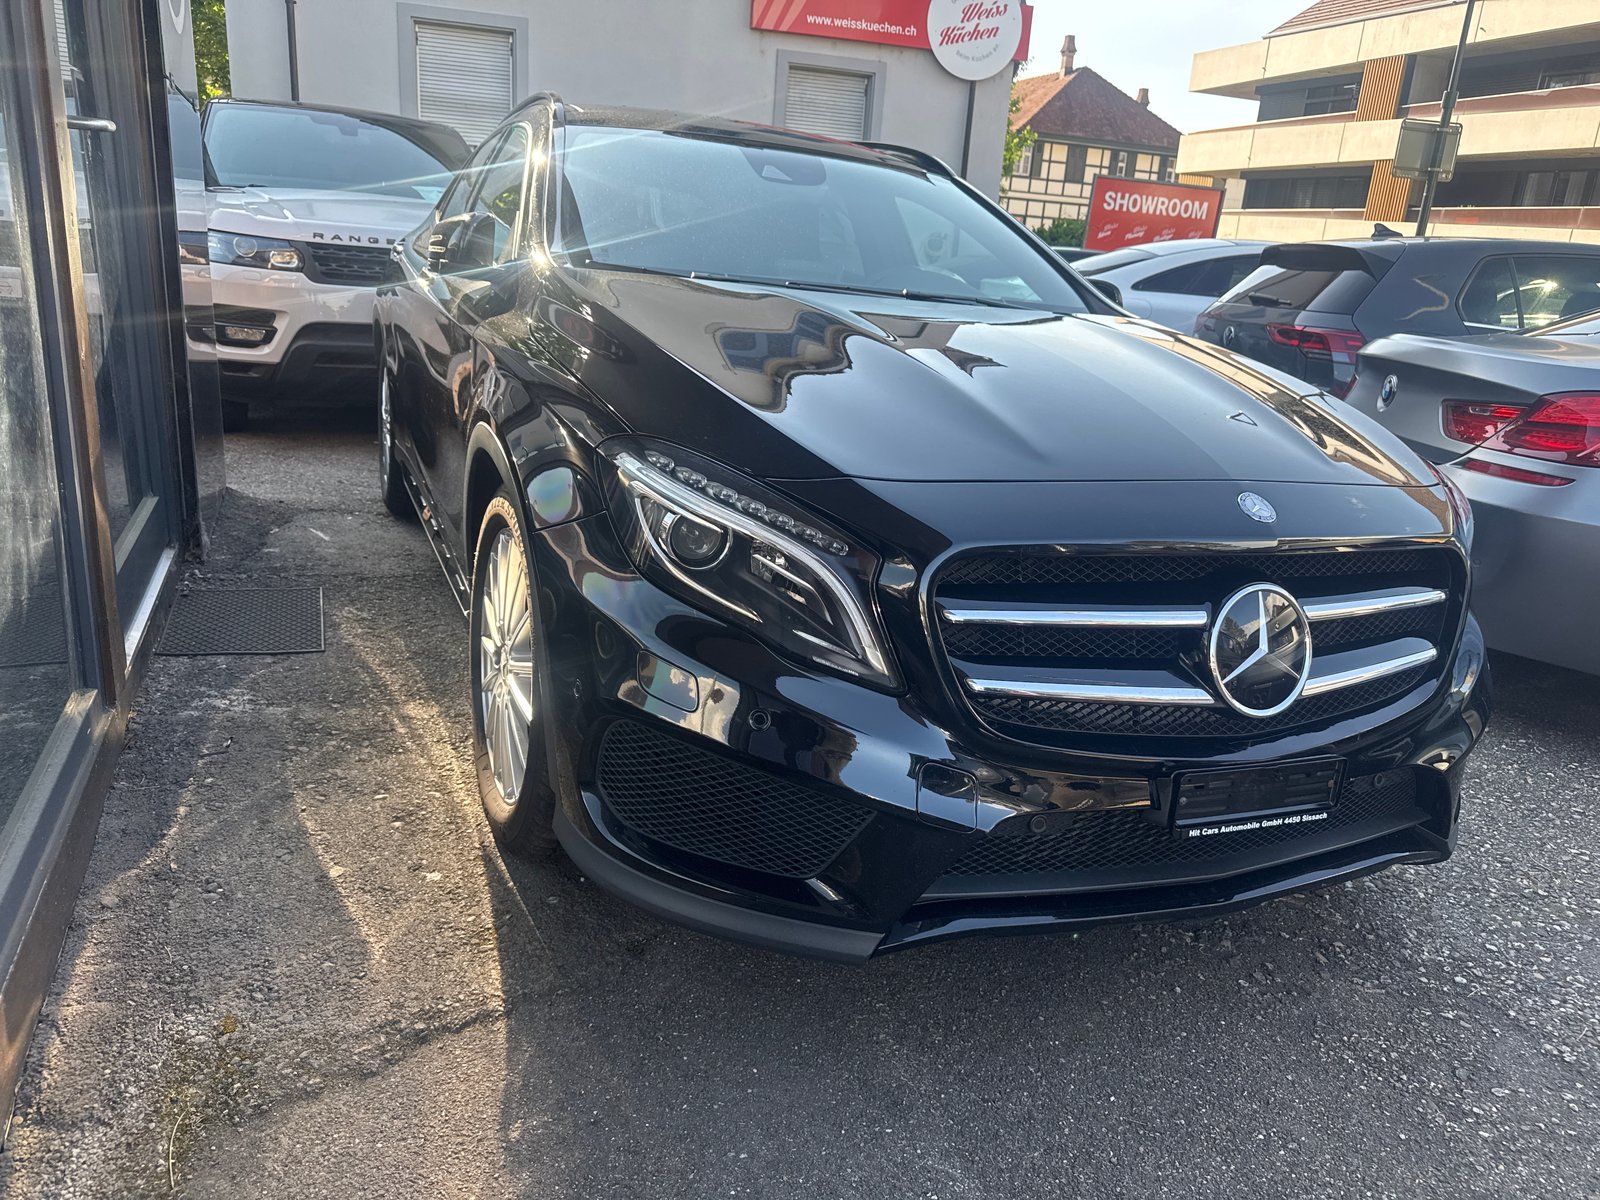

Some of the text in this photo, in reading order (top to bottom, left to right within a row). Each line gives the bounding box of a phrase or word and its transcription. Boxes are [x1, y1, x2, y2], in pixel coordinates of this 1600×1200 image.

[960, 1, 1008, 23] Weiss
[806, 14, 917, 36] www.weisskuechen.ch
[939, 22, 999, 46] Küchen
[1103, 191, 1209, 220] SHOWROOM
[312, 232, 397, 245] RANGE
[1189, 829, 1200, 837] Hit
[1220, 822, 1260, 833] Automobile
[1261, 818, 1283, 827] GmbH
[1284, 816, 1300, 824] 4450
[1302, 812, 1328, 822] Sissach
